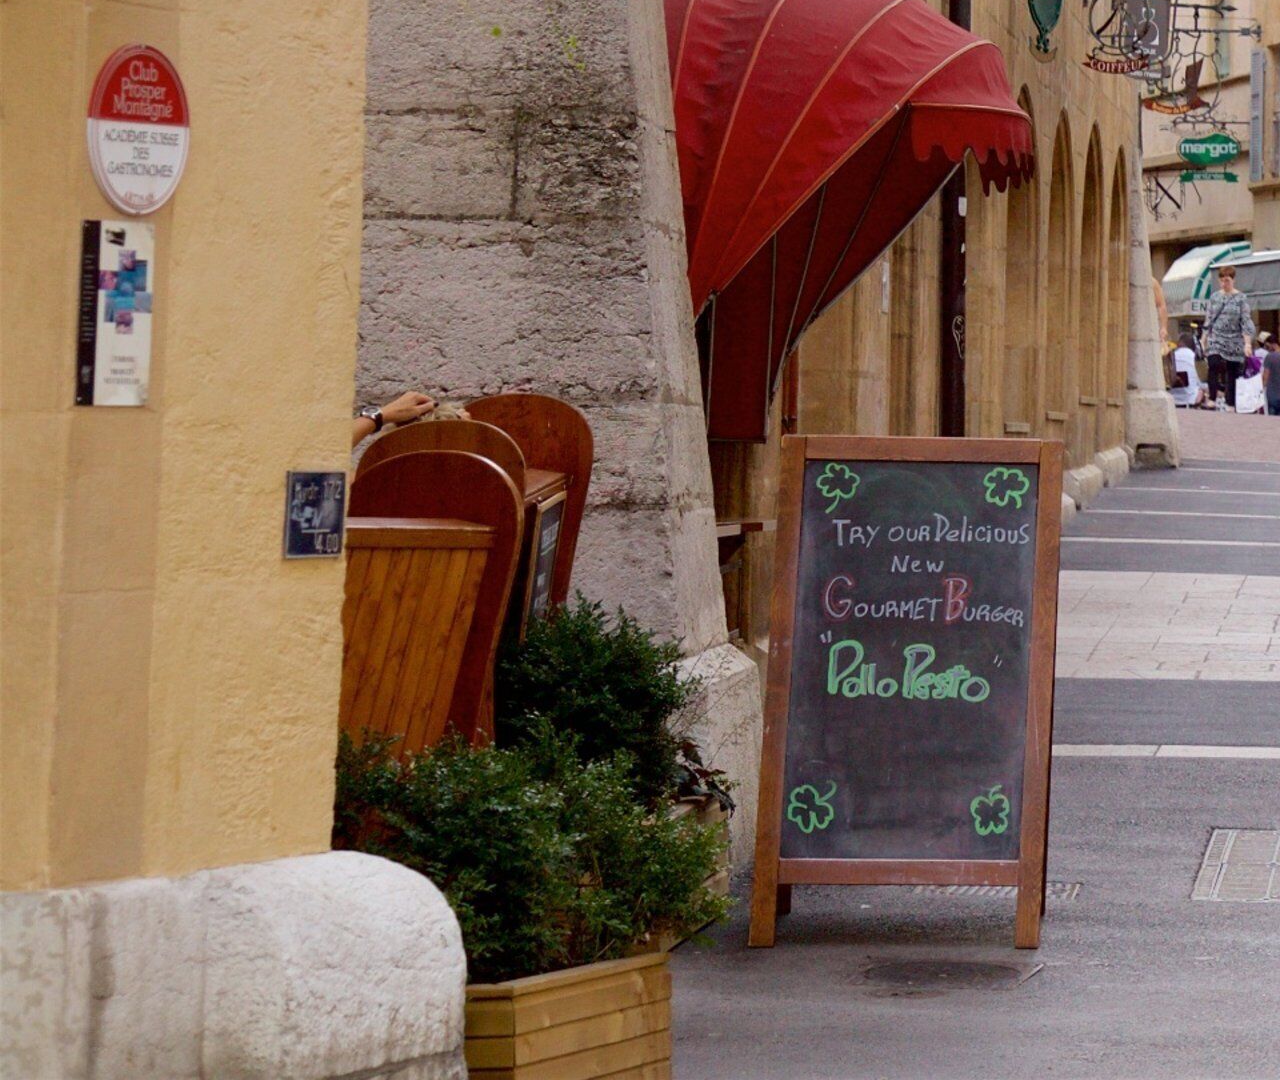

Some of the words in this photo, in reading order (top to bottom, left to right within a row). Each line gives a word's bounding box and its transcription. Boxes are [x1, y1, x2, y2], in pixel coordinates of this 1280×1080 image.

[128, 60, 159, 82] Club
[120, 77, 167, 101] Prosper
[113, 94, 174, 122] Montagné
[132, 146, 150, 161] DES
[1180, 142, 1238, 158] margot
[107, 160, 174, 178] GASTRONOMES
[887, 524, 931, 542] OUR
[933, 512, 1030, 545] Delicious
[891, 554, 944, 573] New
[824, 575, 943, 622] GOURMET
